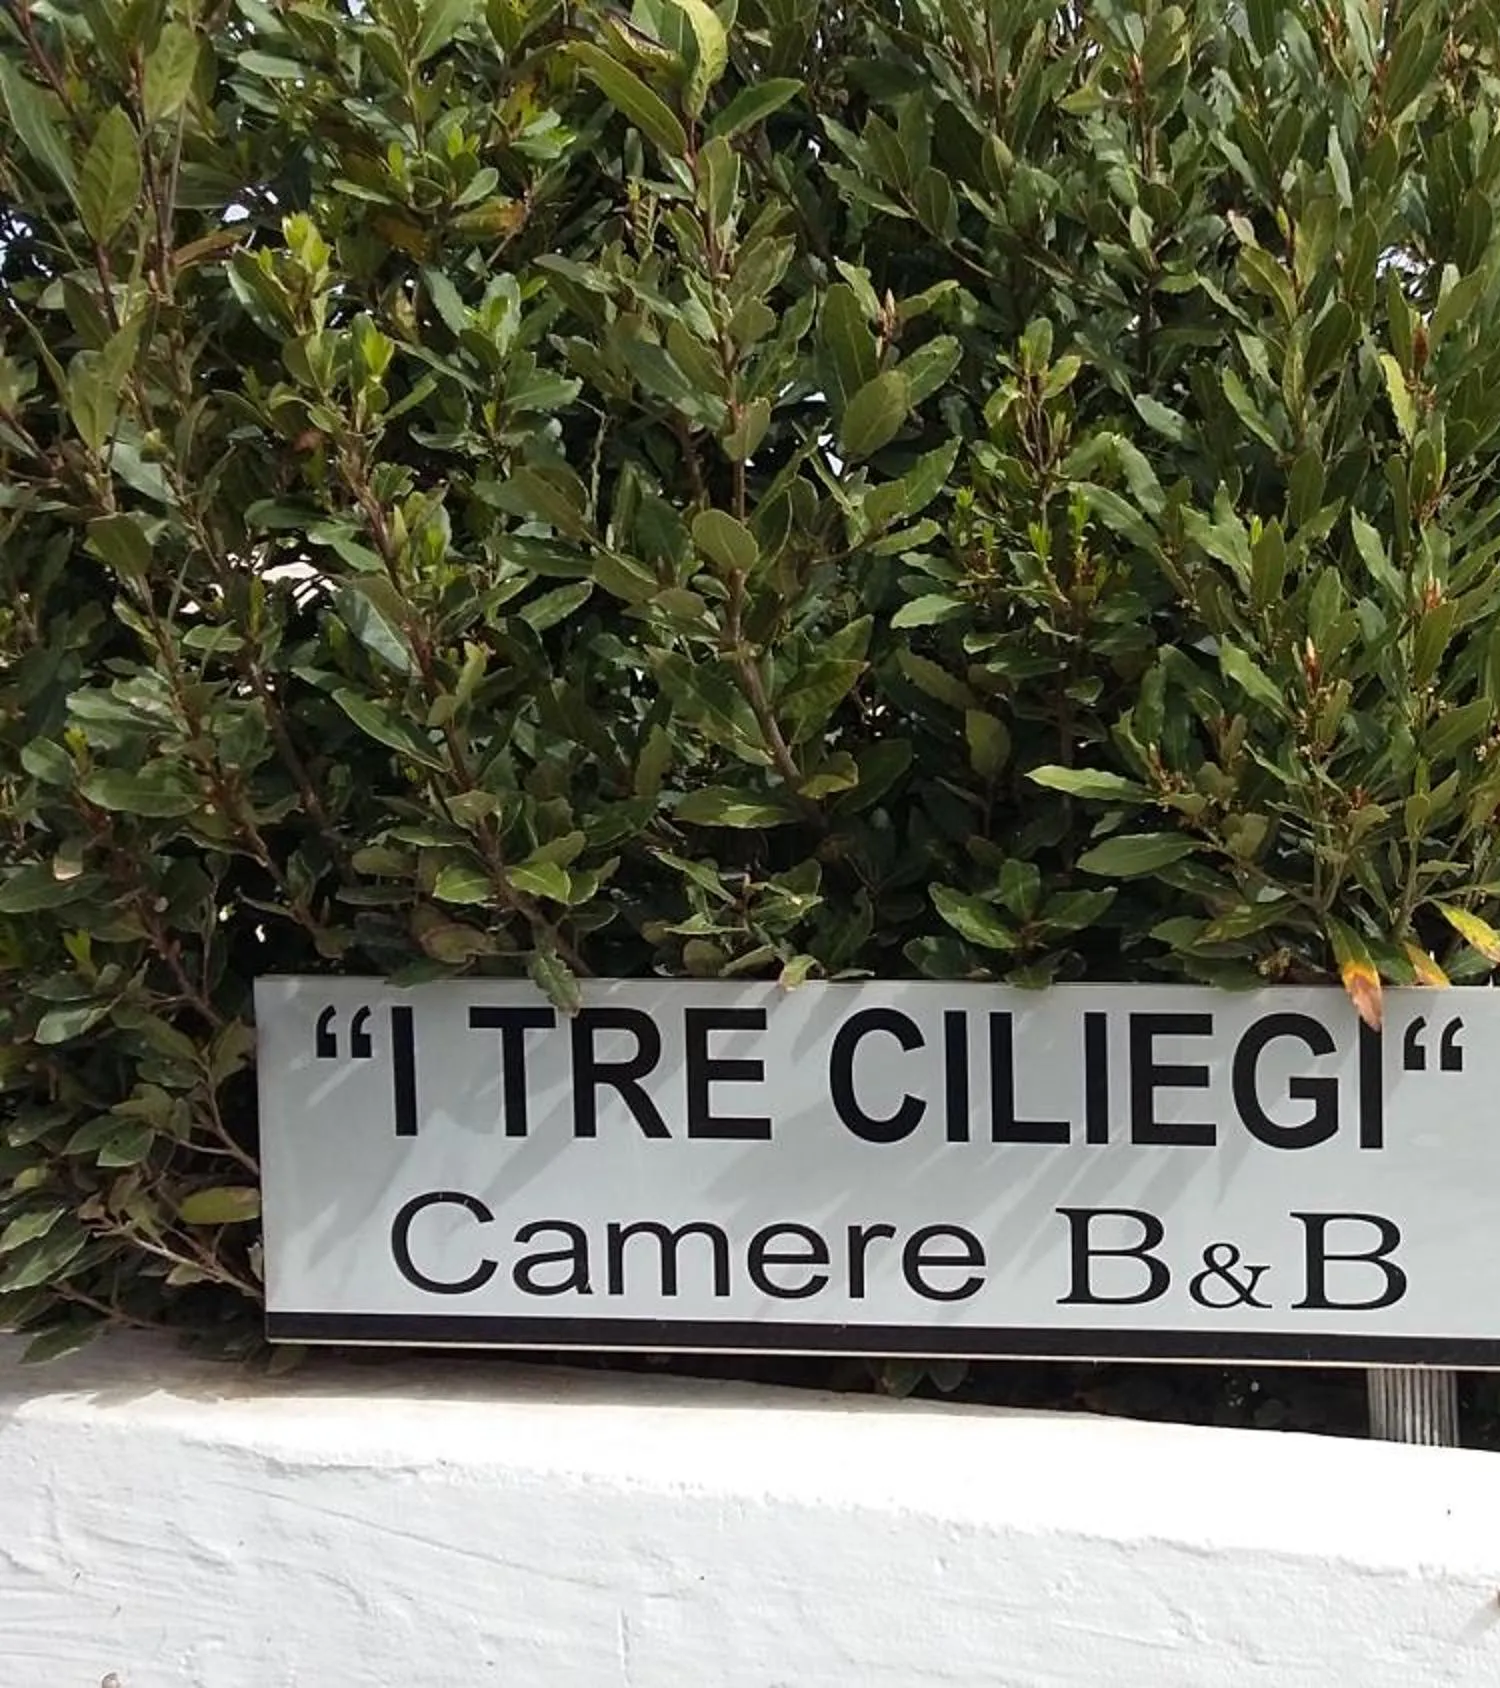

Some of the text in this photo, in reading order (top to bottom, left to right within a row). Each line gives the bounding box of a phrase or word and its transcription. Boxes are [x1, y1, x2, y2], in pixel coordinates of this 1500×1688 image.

[468, 1005, 773, 1141] TRE
[390, 1190, 1408, 1311] Camere B&B
